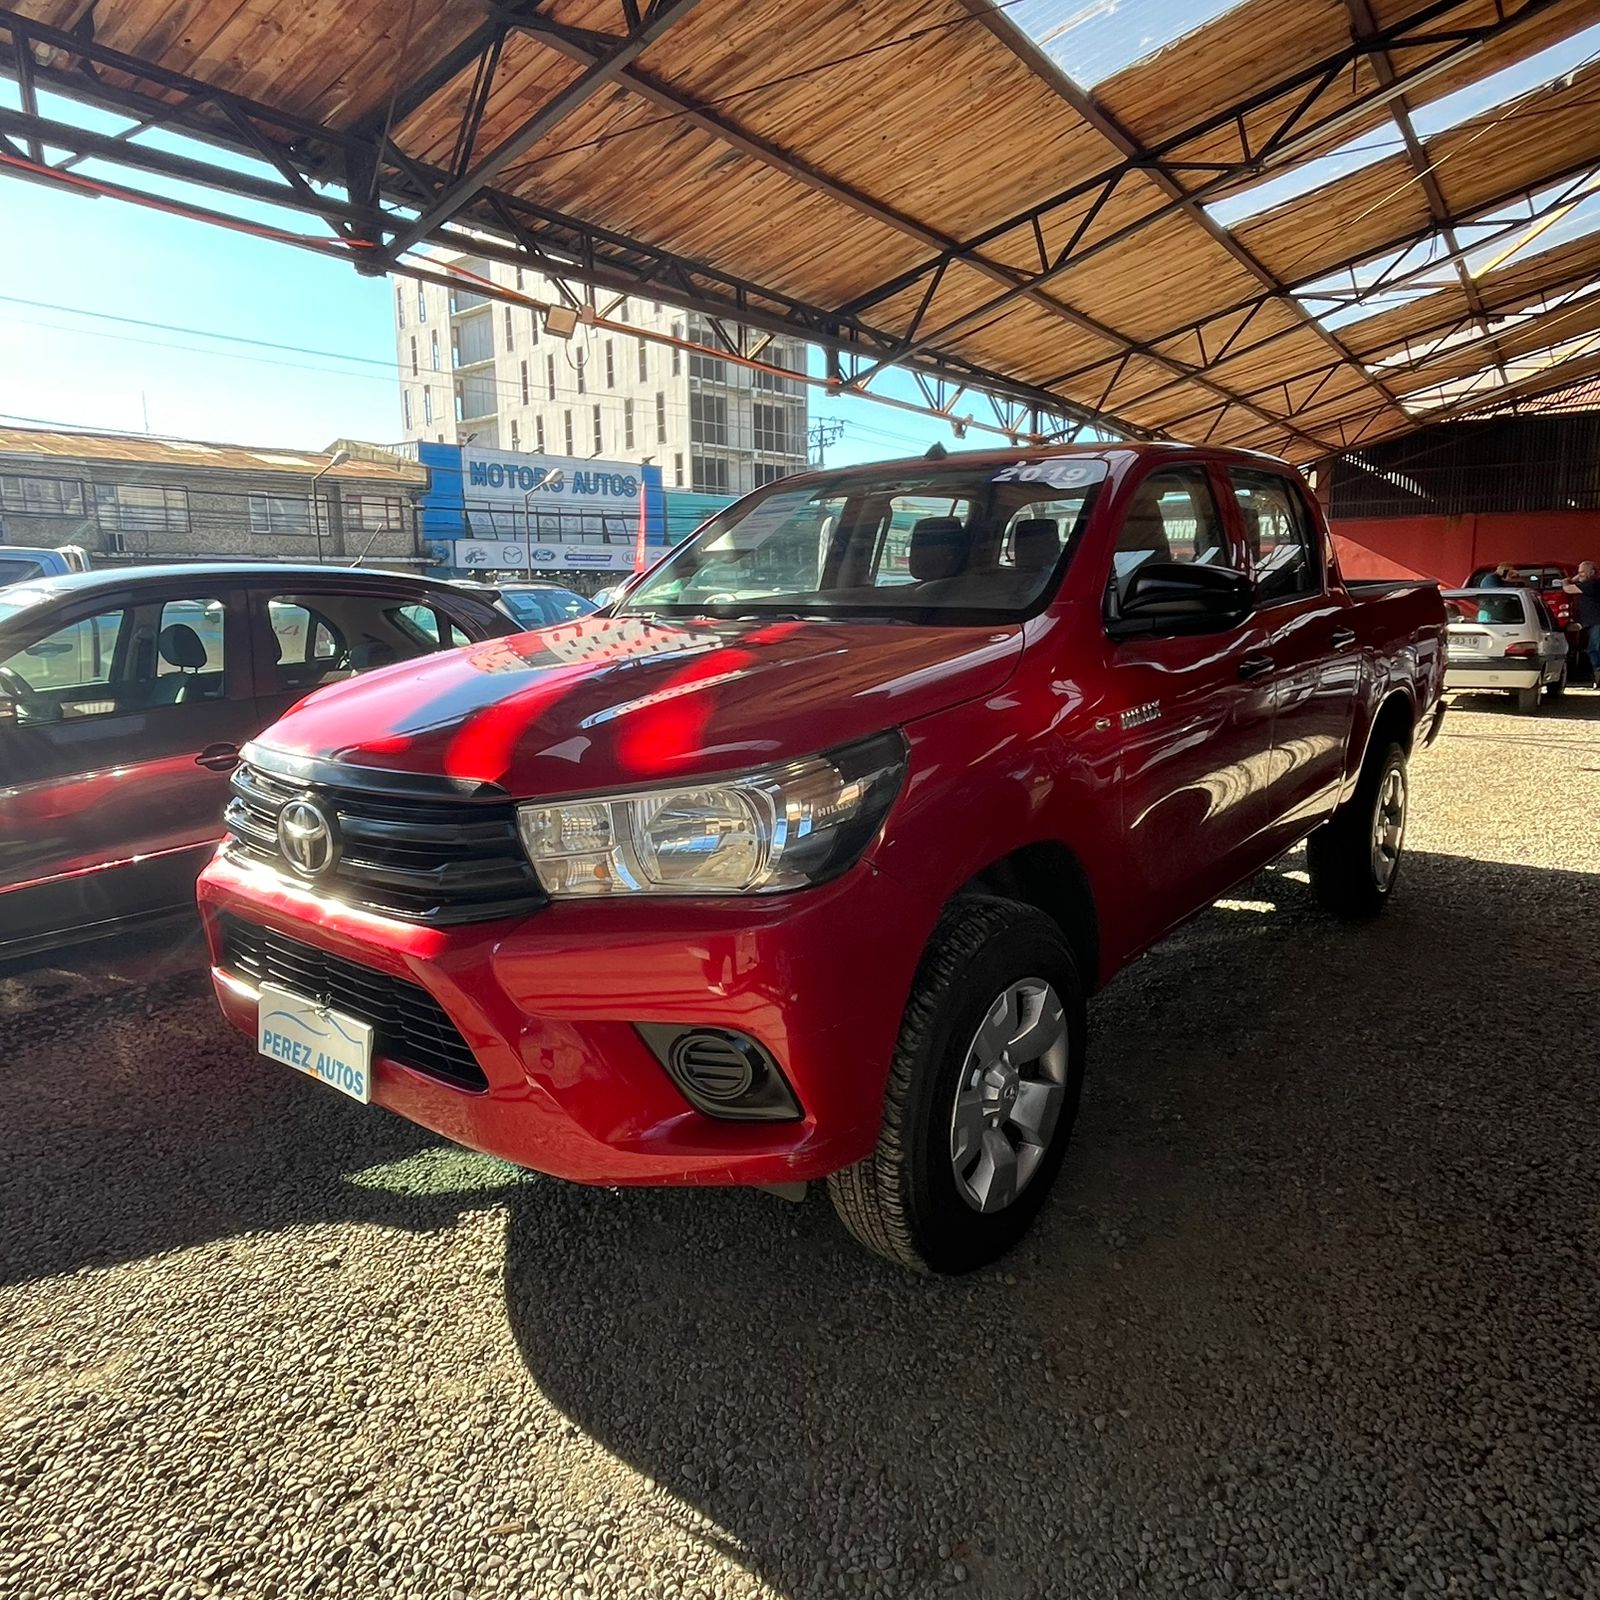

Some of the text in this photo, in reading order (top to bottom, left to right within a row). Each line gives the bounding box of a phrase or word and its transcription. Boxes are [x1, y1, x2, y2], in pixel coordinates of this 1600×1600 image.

[572, 471, 637, 497] AUTOS
[992, 466, 1087, 482] 2019
[263, 1029, 363, 1095] PEREZ AUTOS
